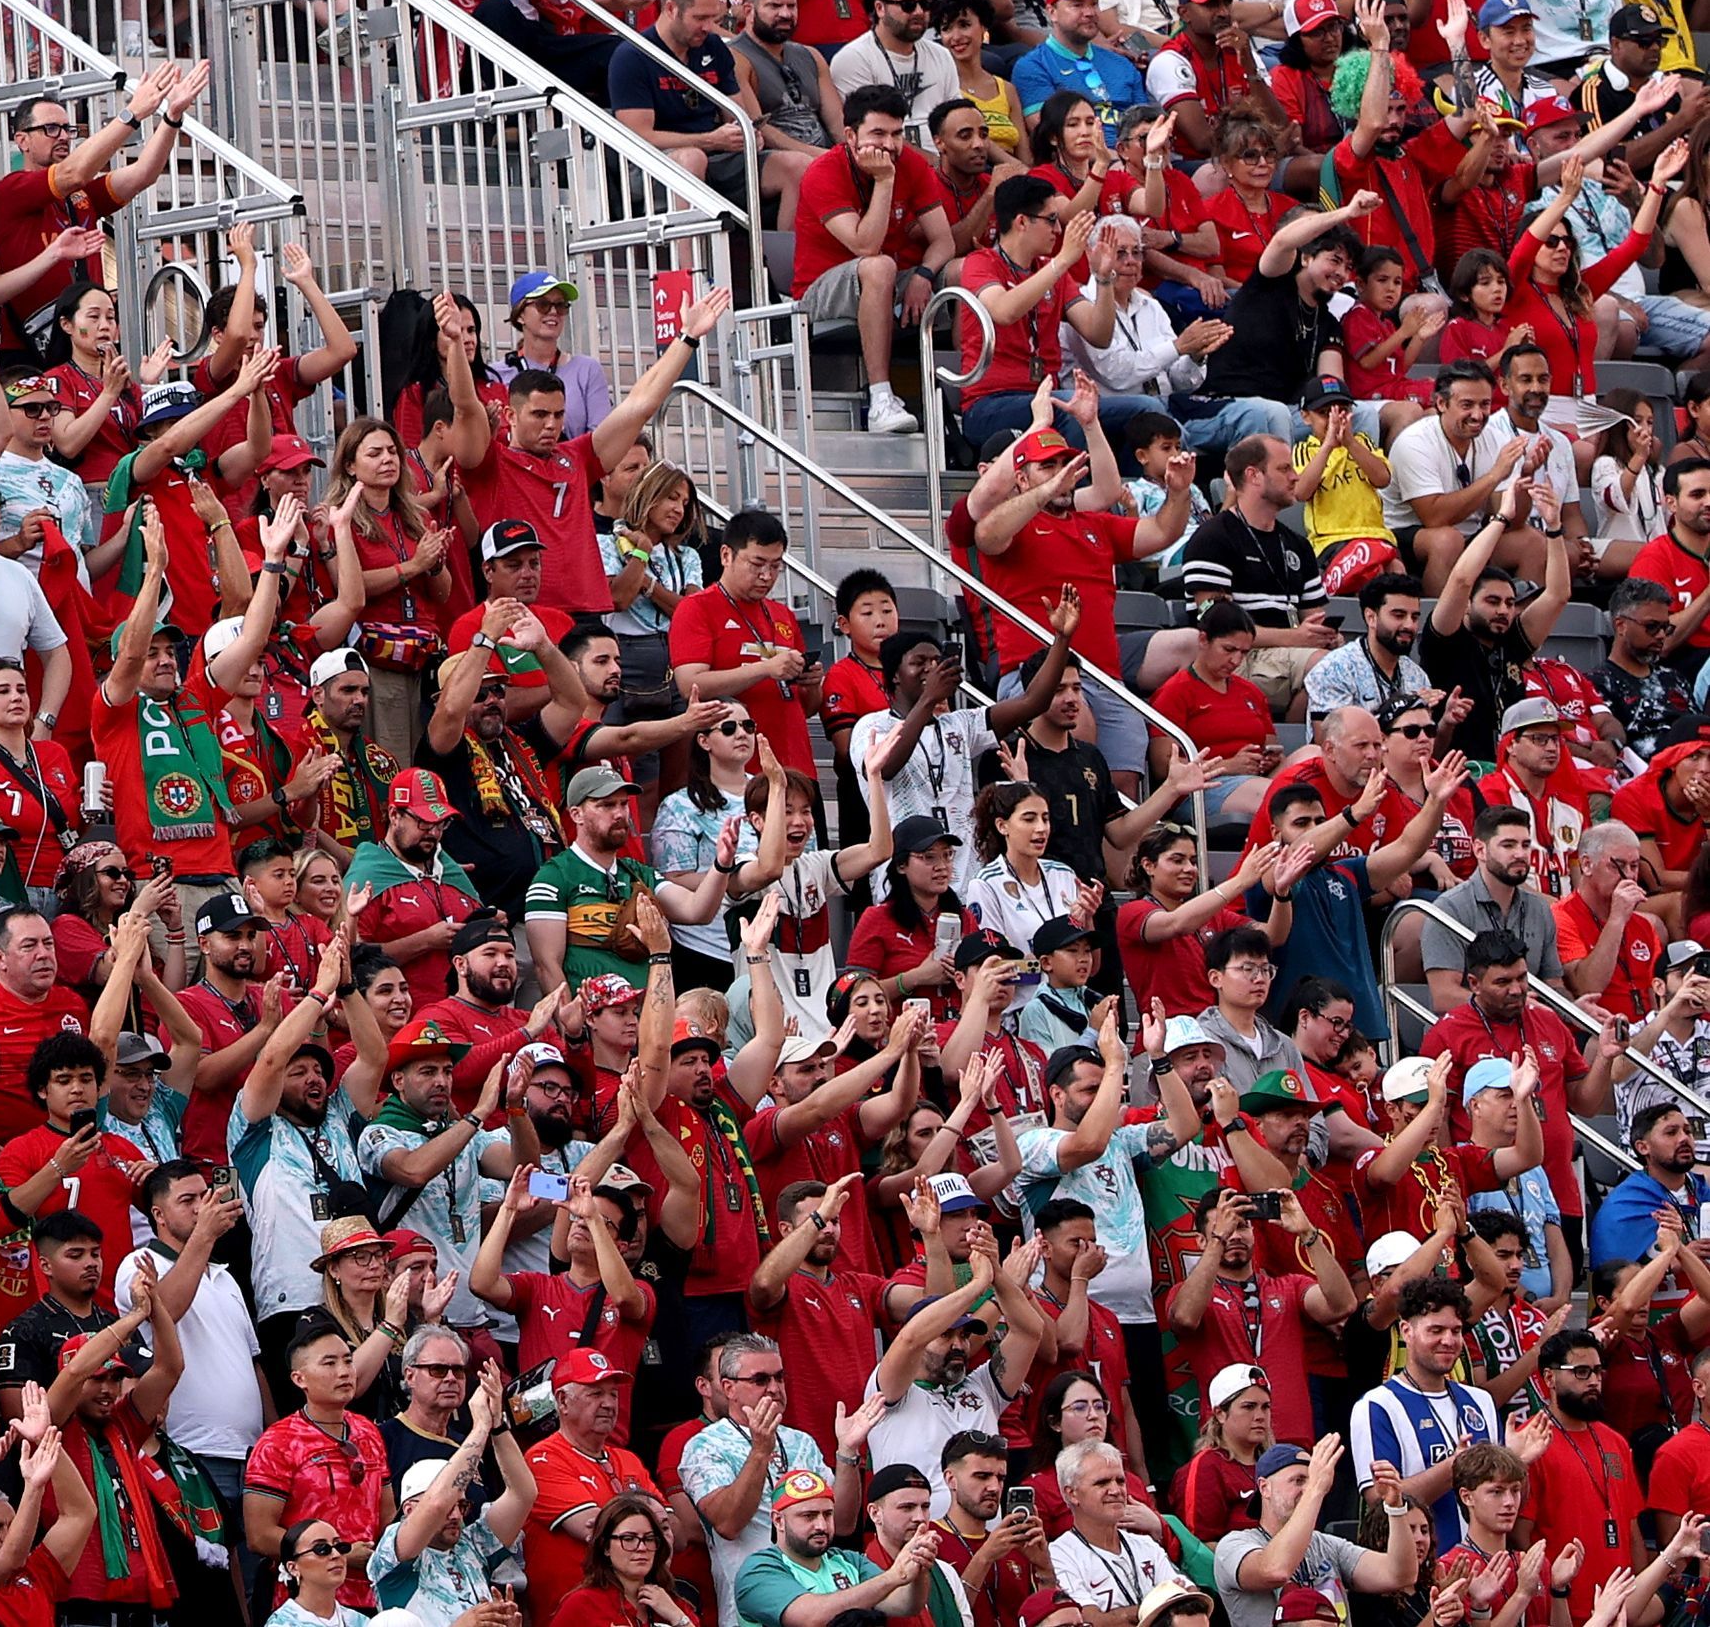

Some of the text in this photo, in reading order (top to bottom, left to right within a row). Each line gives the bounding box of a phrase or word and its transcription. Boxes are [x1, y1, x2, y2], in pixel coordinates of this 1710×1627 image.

[657, 323, 675, 340] 234
[552, 481, 568, 518] 7
[5, 788, 22, 816] 7
[1065, 794, 1079, 826] 7
[62, 1176, 81, 1210] 7
[1096, 1589, 1114, 1613] 7
